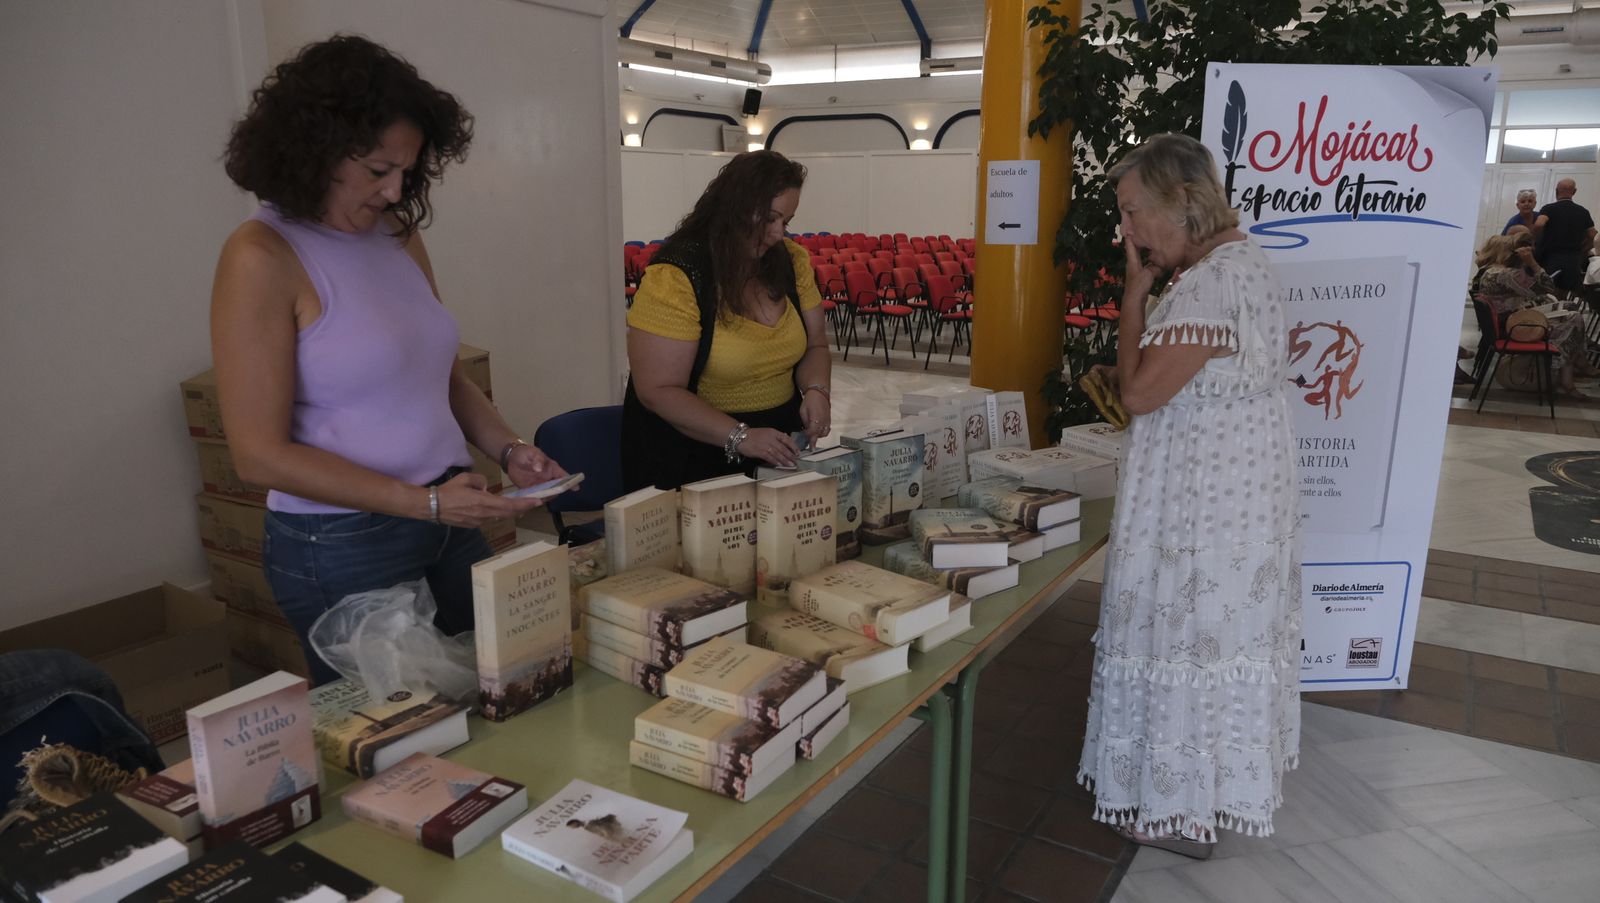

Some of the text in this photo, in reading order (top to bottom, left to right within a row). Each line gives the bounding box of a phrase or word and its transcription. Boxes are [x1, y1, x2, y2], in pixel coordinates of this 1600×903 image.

[1248, 94, 1434, 187] Mojácar
[990, 167, 1028, 176] Escuela de
[989, 190, 1014, 199] adultos
[1225, 161, 1427, 221] Espacio literario
[1286, 282, 1386, 301] IA NAVARRO
[890, 447, 912, 457] JULIA
[883, 454, 918, 467] NAVARRO
[1298, 455, 1349, 468] ARTIDA
[1303, 475, 1336, 486] sin ellos,
[1323, 488, 1342, 497] ellos
[716, 500, 751, 515] JULIA
[791, 496, 823, 511] JULIA
[784, 506, 832, 524] NAVARRO
[724, 525, 744, 535] DIME
[798, 521, 816, 531] DIME
[517, 567, 547, 587] JULIA
[508, 576, 557, 602] NAVARRO
[509, 591, 557, 617] LA SANGRE
[506, 609, 561, 639] INOCENTES
[1303, 654, 1333, 664] NAS
[237, 704, 280, 732] JULIA
[223, 713, 297, 748] NAVARRO
[246, 757, 257, 767] de
[534, 793, 593, 836] NAVARRO
[536, 799, 574, 825] JULIA
[592, 843, 610, 858] DE
[620, 828, 659, 865] PARTE
